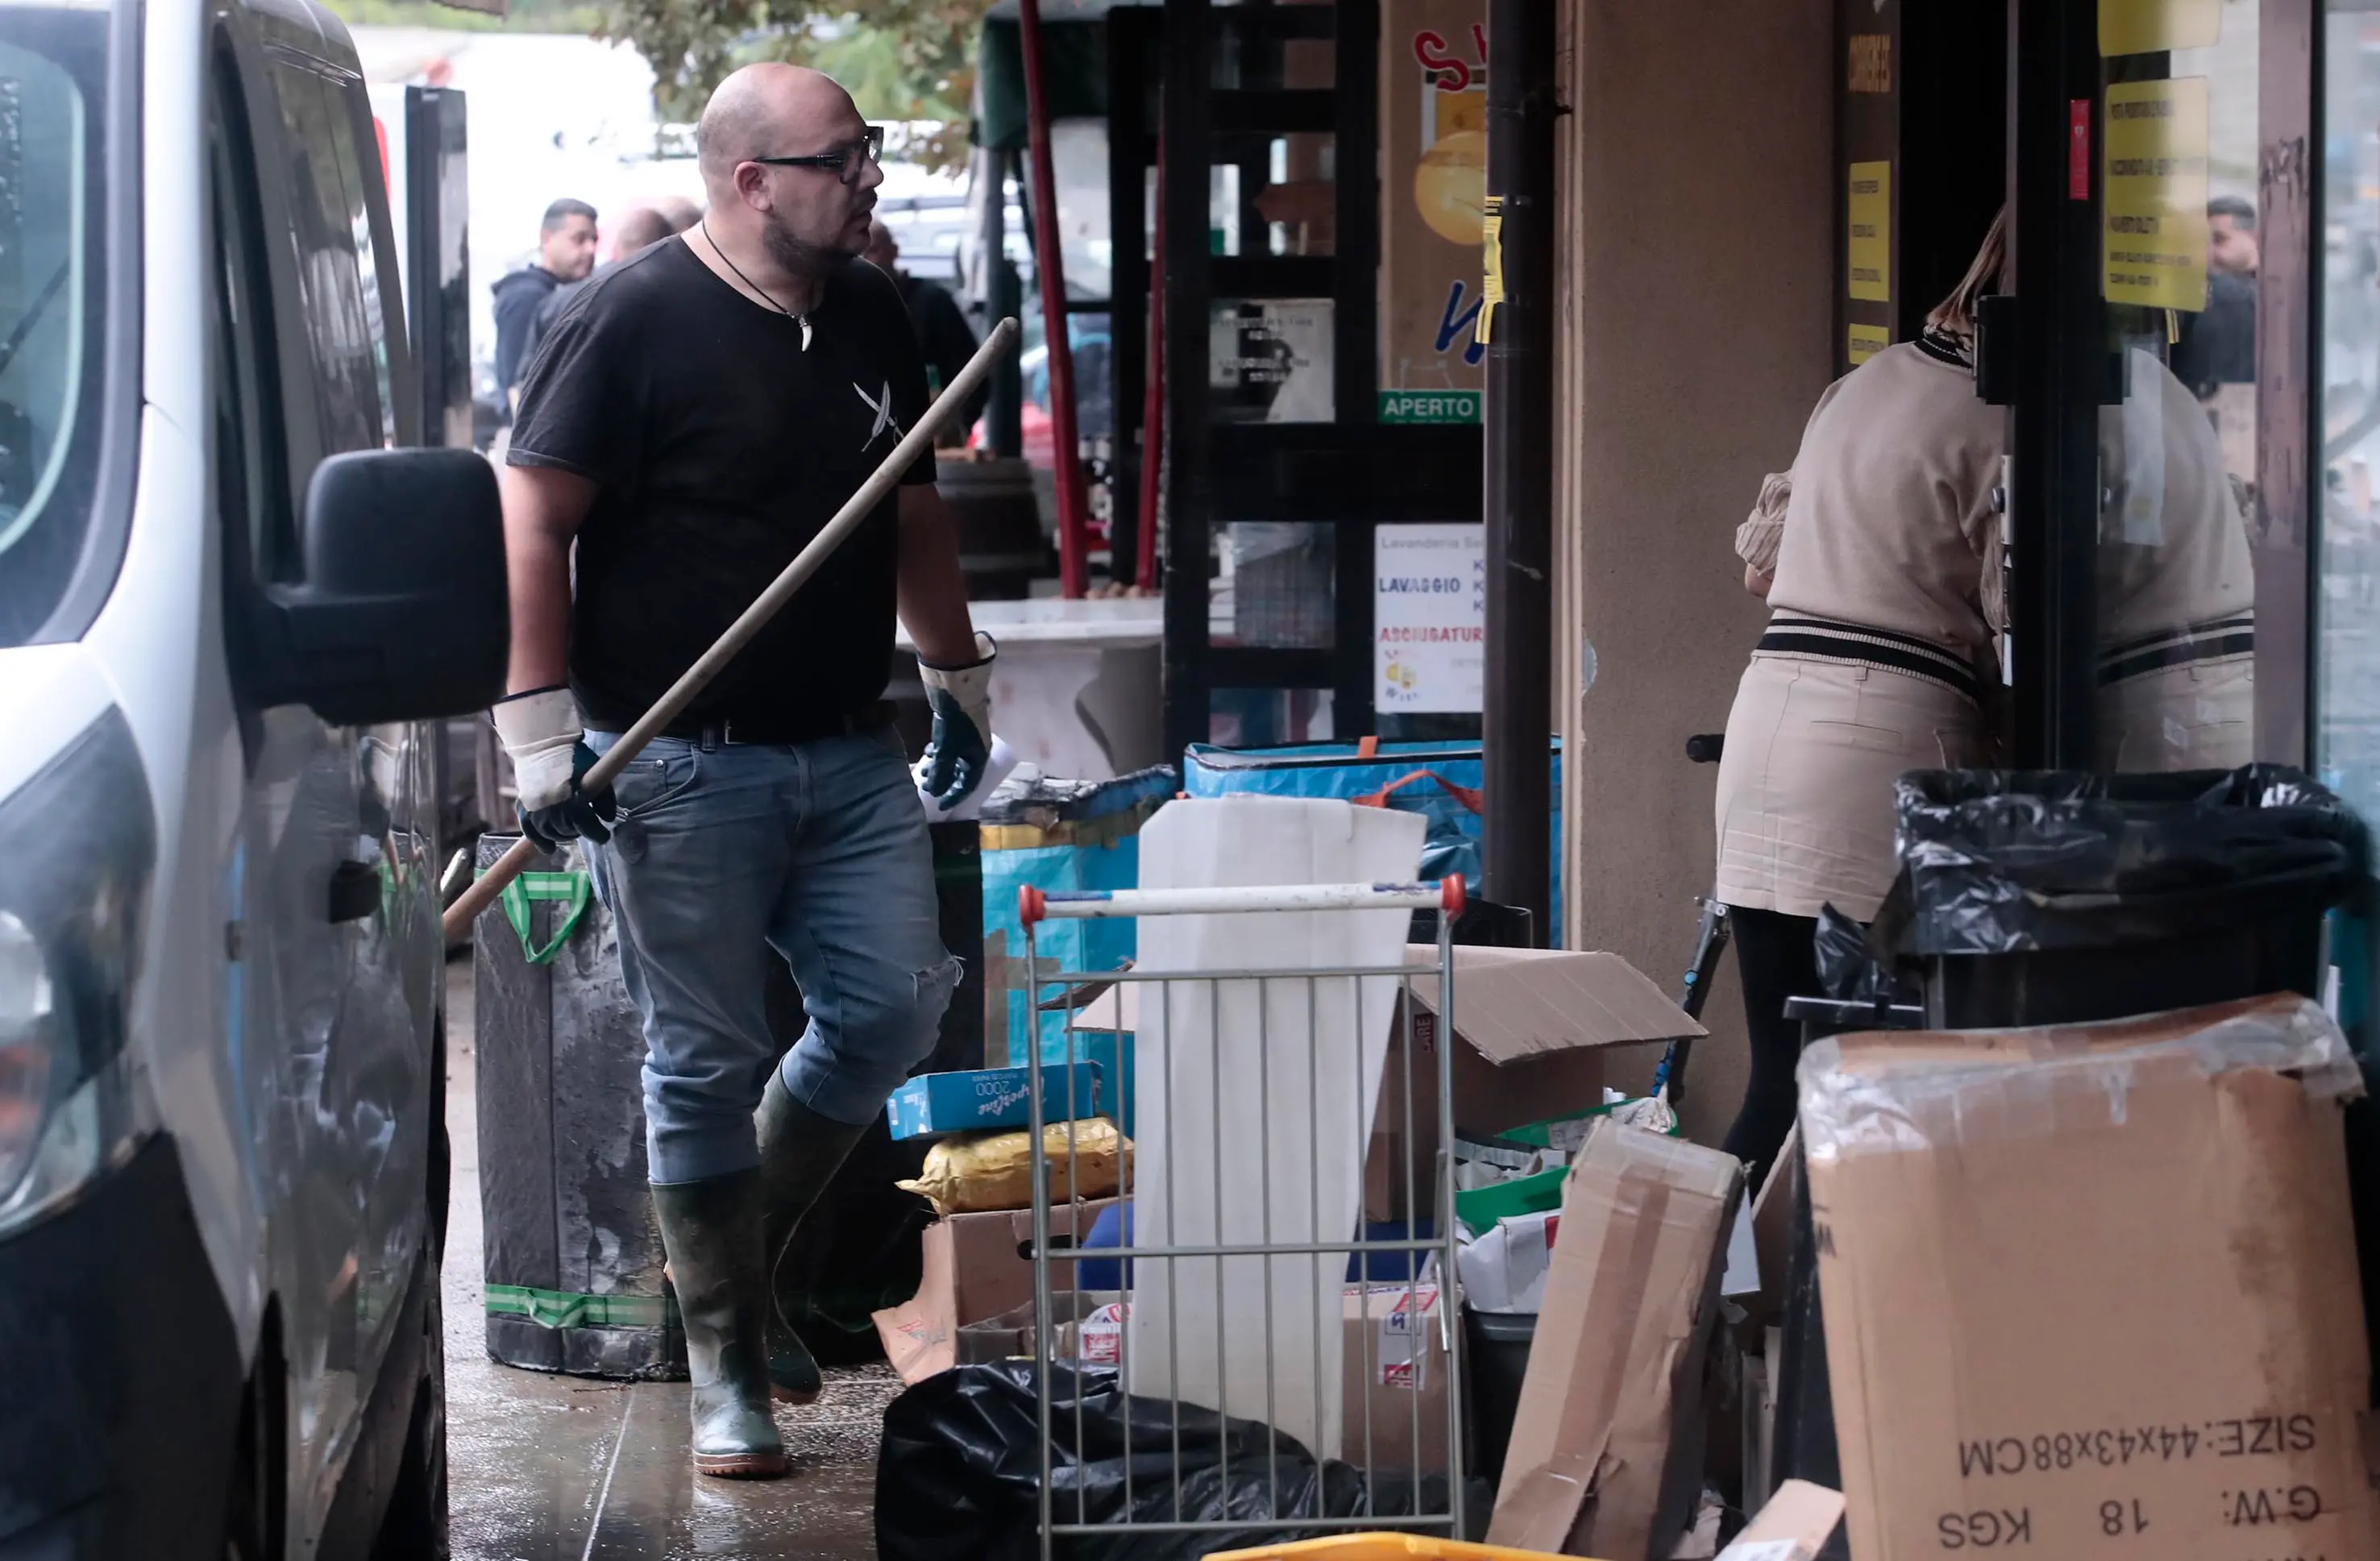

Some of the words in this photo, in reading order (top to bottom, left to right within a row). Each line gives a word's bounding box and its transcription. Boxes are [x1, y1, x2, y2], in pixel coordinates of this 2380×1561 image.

[1385, 397, 1474, 417] APERTO
[1379, 578, 1461, 592] LAVAGGIO
[975, 1081, 1011, 1096] 2000
[2100, 1499, 2149, 1536] 18
[1938, 1508, 2030, 1550] KGS
